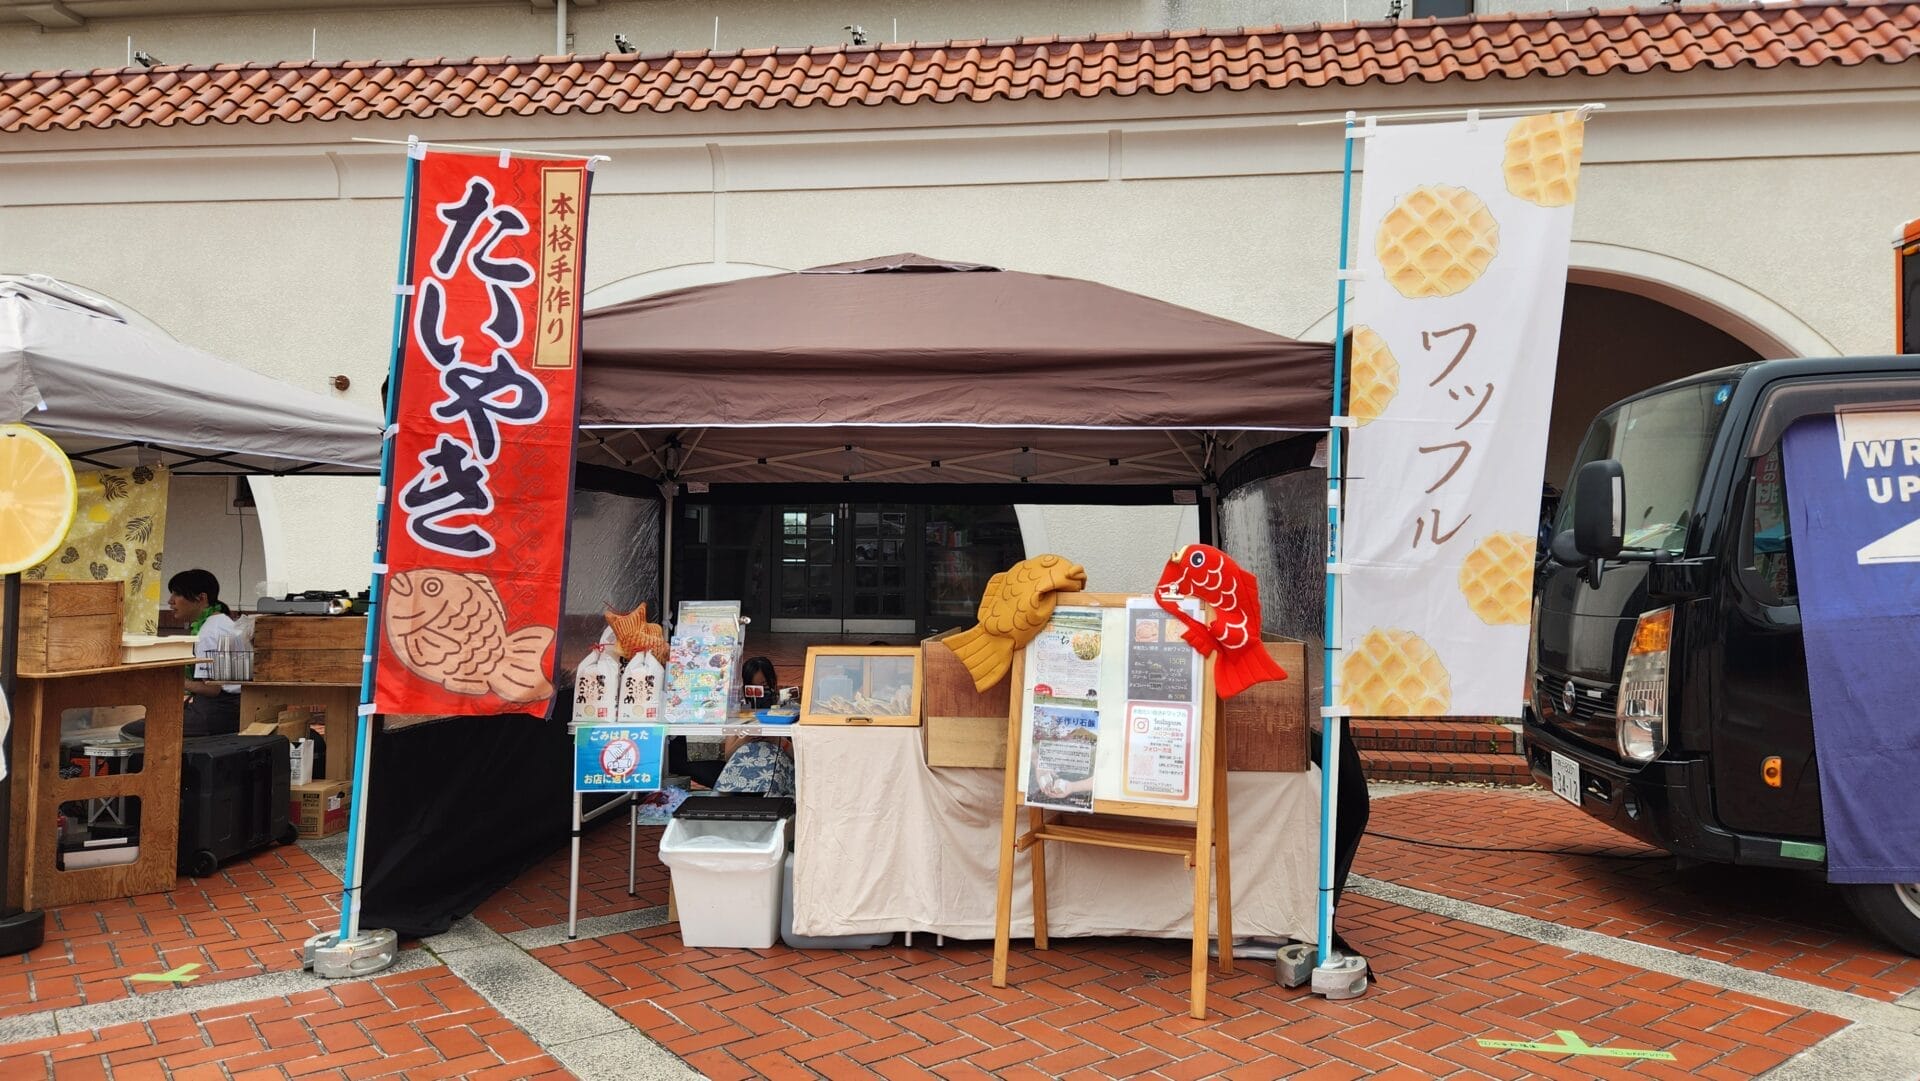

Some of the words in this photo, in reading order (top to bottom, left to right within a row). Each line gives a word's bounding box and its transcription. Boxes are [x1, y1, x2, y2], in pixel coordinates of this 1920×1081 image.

[545, 192, 576, 345] 本格手作り
[400, 177, 547, 556] たいやき
[1412, 322, 1495, 549] ワッフル
[1866, 475, 1920, 503] UP
[624, 677, 637, 704] おこめ
[590, 729, 649, 741] ごみは買った
[584, 772, 651, 785] お店に返してね
